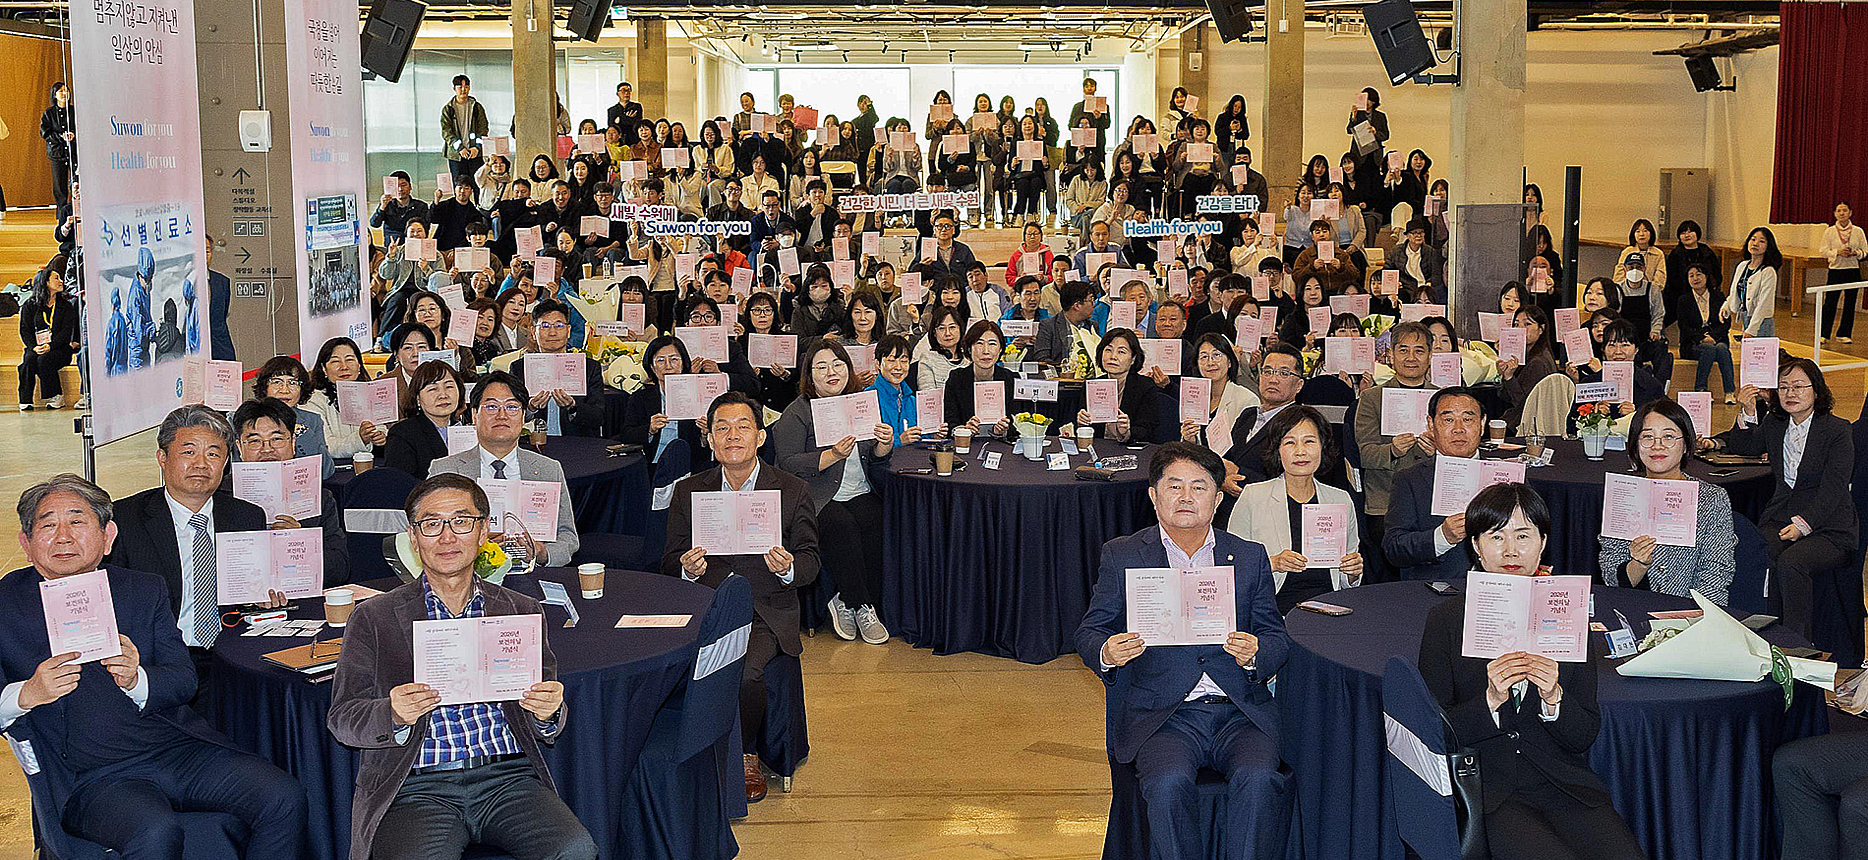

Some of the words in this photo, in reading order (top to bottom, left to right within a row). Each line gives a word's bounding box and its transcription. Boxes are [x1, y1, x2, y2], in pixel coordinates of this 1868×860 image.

[149, 6, 178, 34] 지켜낸
[111, 34, 143, 62] 일상의
[145, 38, 163, 64] 안심
[110, 114, 143, 137] Suwon
[144, 118, 157, 137] for
[110, 151, 144, 170] Health
[146, 151, 159, 170] for
[839, 197, 876, 211] 건강한
[877, 196, 900, 210] 시민
[904, 195, 916, 209] 더
[918, 194, 929, 209] 큰
[932, 193, 954, 208] 새빛
[956, 192, 979, 208] 수원
[1197, 197, 1233, 212] 건강을
[1234, 196, 1258, 211] 담다
[611, 204, 635, 220] 새빛
[639, 206, 677, 222] 수원에
[121, 213, 192, 247] 선별진료소
[646, 220, 696, 235] Suwon
[698, 219, 720, 233] for
[722, 222, 750, 237] you
[1125, 219, 1170, 236] Health
[1171, 219, 1193, 235] for
[1195, 221, 1222, 235] you
